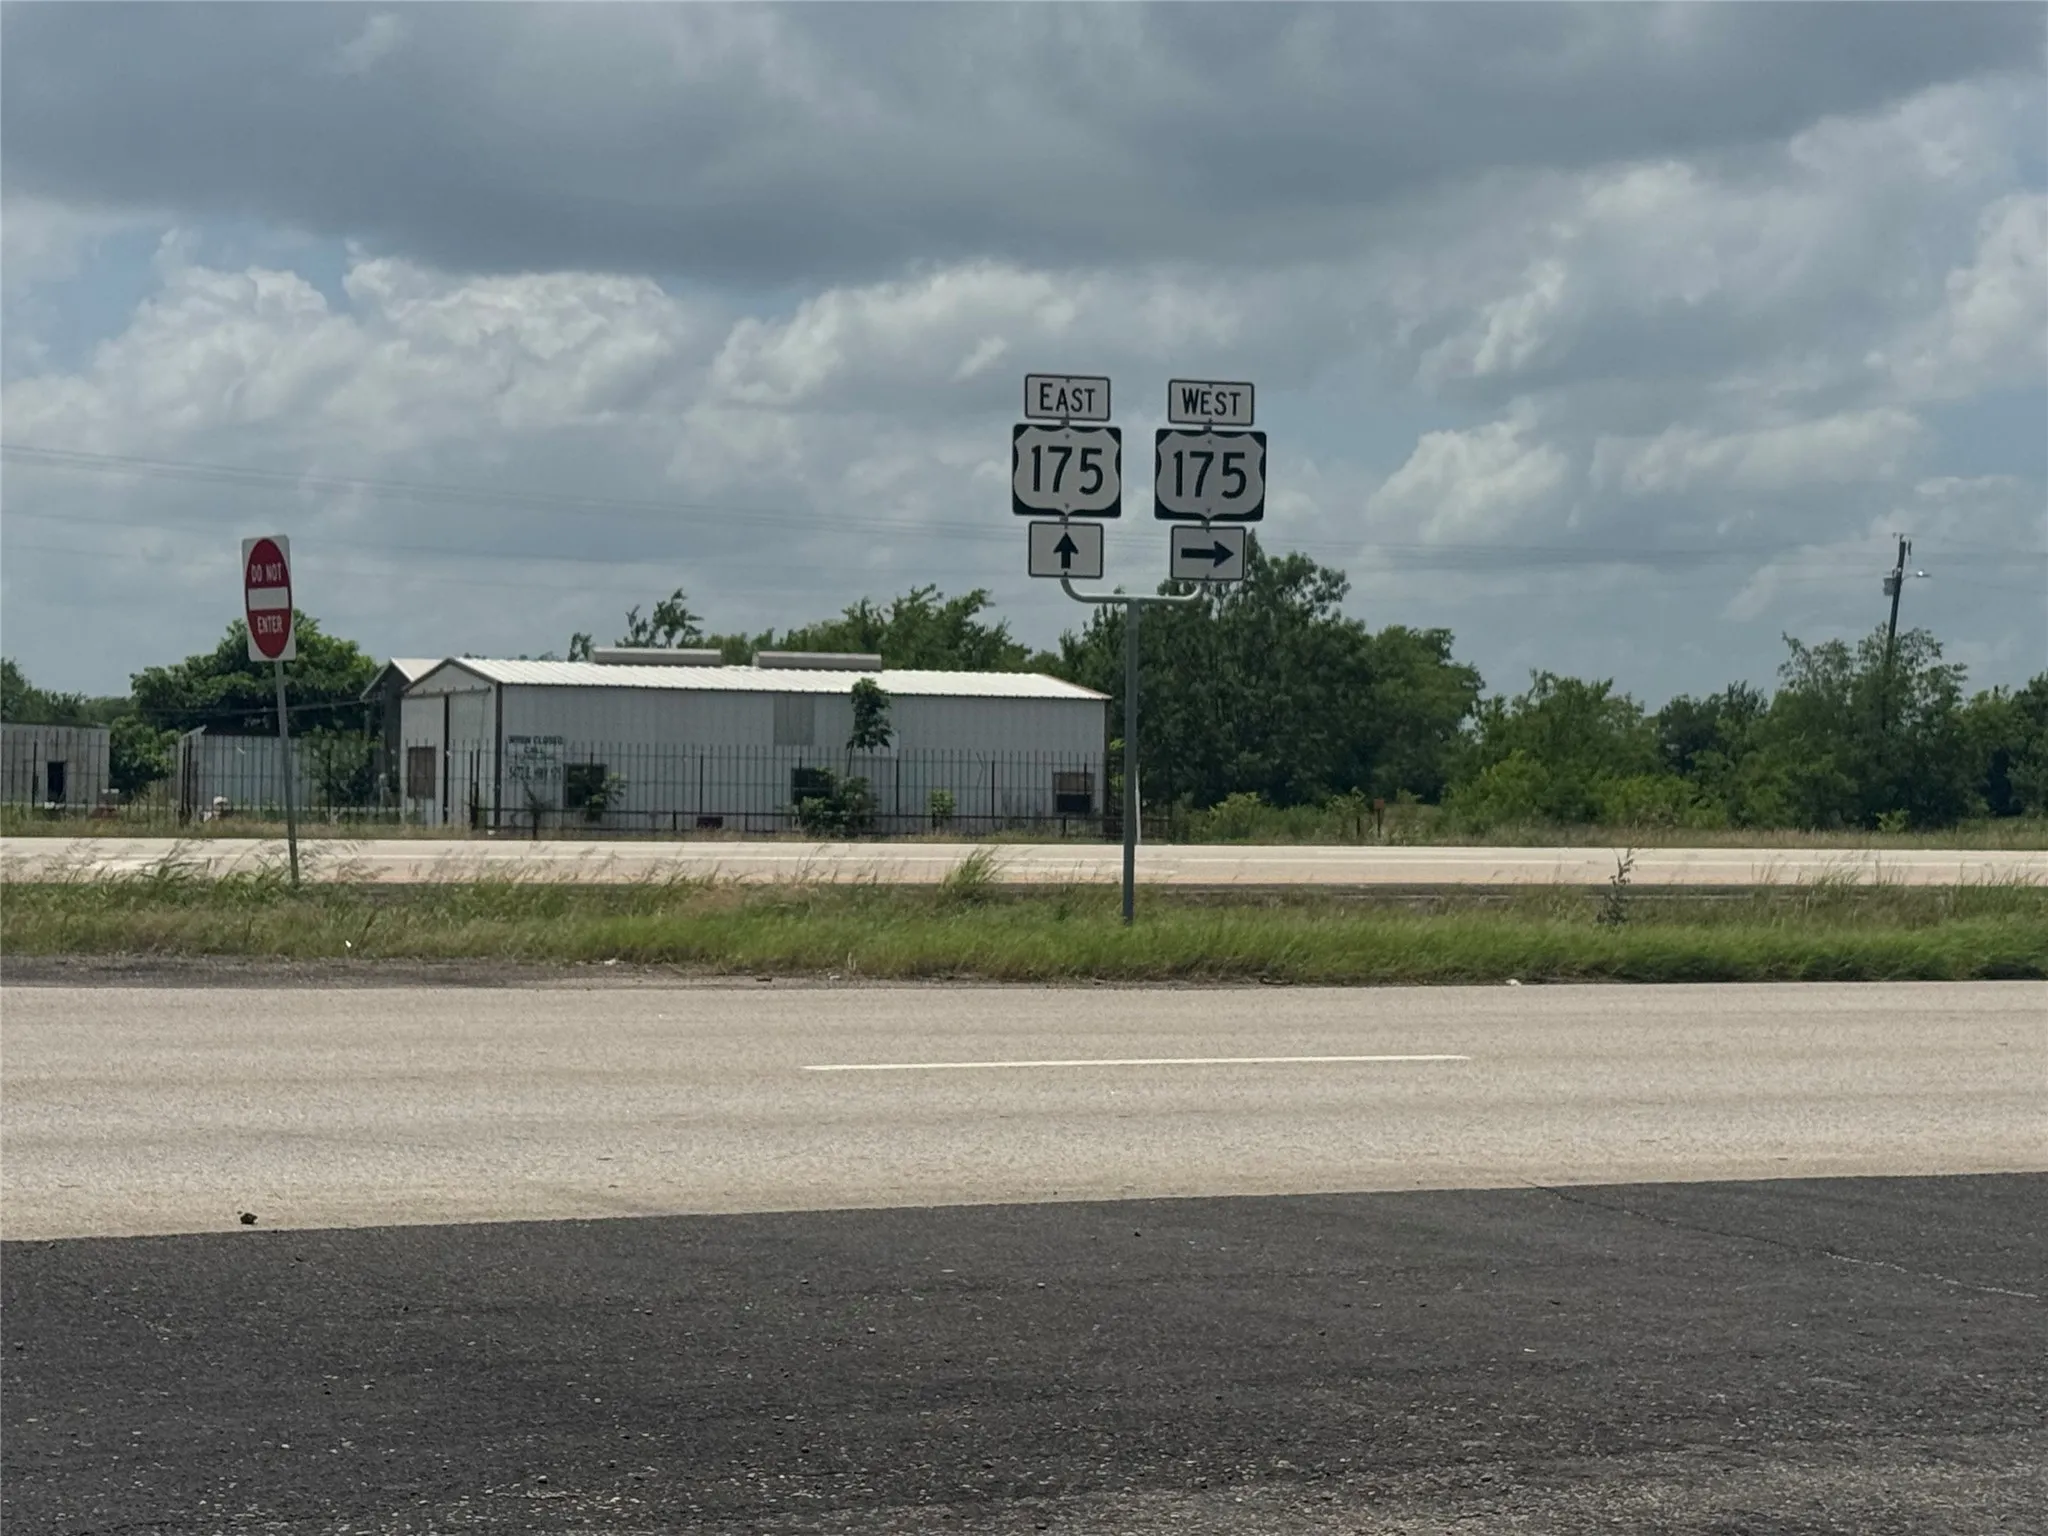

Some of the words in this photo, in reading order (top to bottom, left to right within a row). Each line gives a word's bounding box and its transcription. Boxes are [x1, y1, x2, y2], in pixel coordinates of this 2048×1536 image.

[1039, 382, 1096, 413] EAST
[1182, 387, 1241, 417] WEST
[1031, 445, 1104, 495] 175
[1173, 450, 1247, 499] 175
[251, 564, 263, 583] DO
[265, 563, 282, 581] NOT
[257, 616, 283, 634] ENTER
